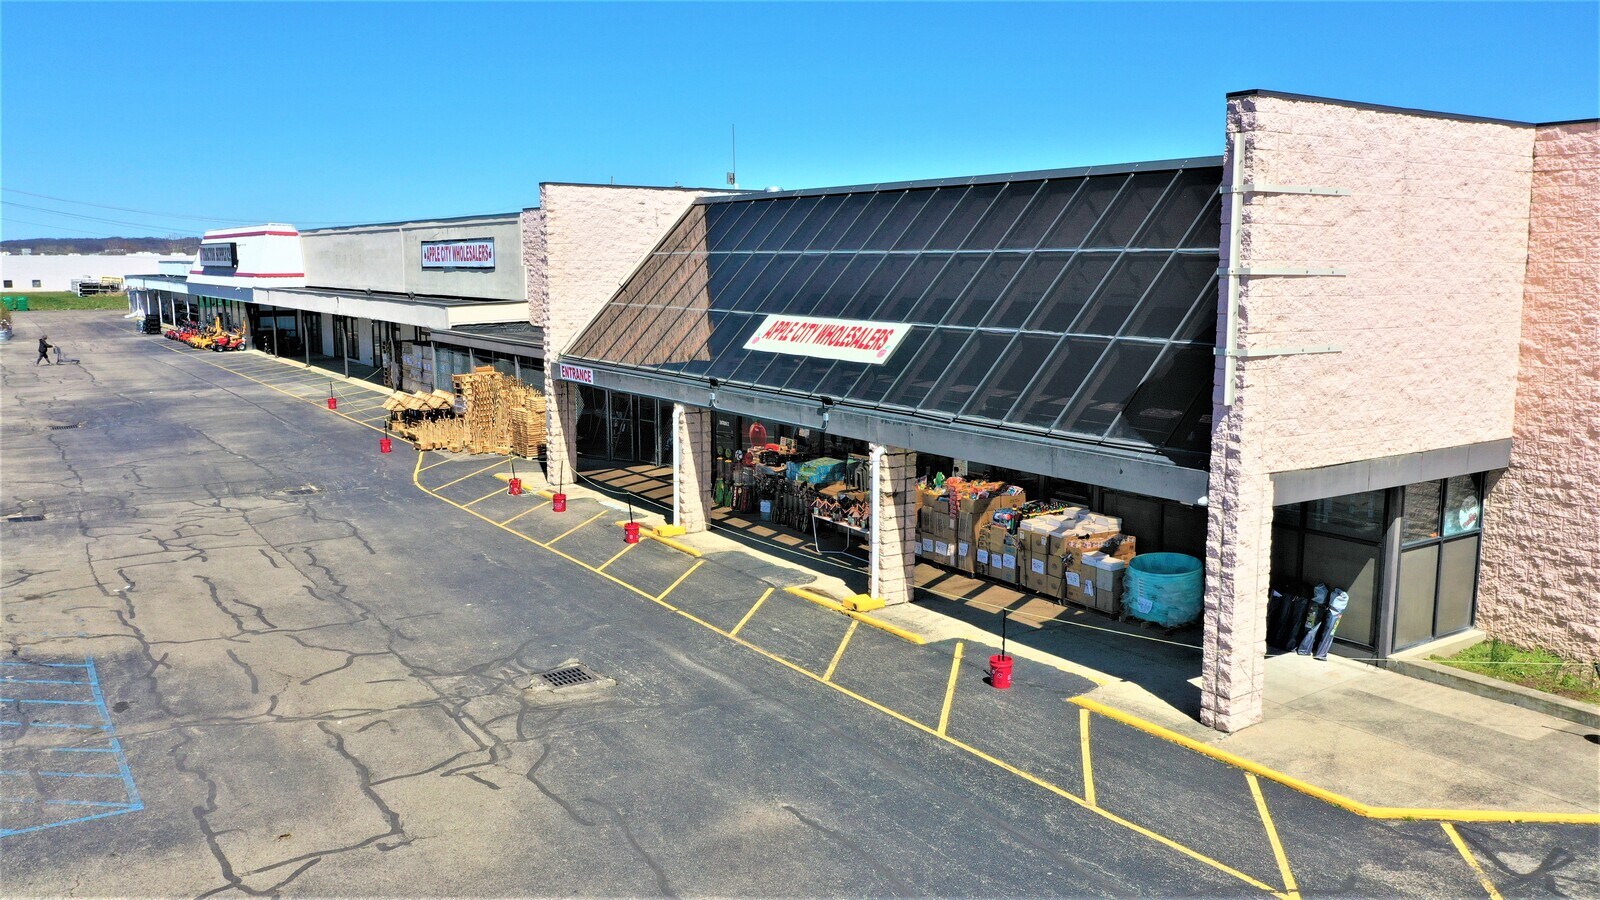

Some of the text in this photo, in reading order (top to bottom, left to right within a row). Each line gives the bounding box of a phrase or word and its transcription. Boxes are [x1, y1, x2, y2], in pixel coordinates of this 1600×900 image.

[426, 244, 489, 262] APPLE CITY WHOLESALERS
[762, 320, 895, 351] APPLE CITY WHOLESALERS
[561, 365, 592, 383] ENTRANCE
